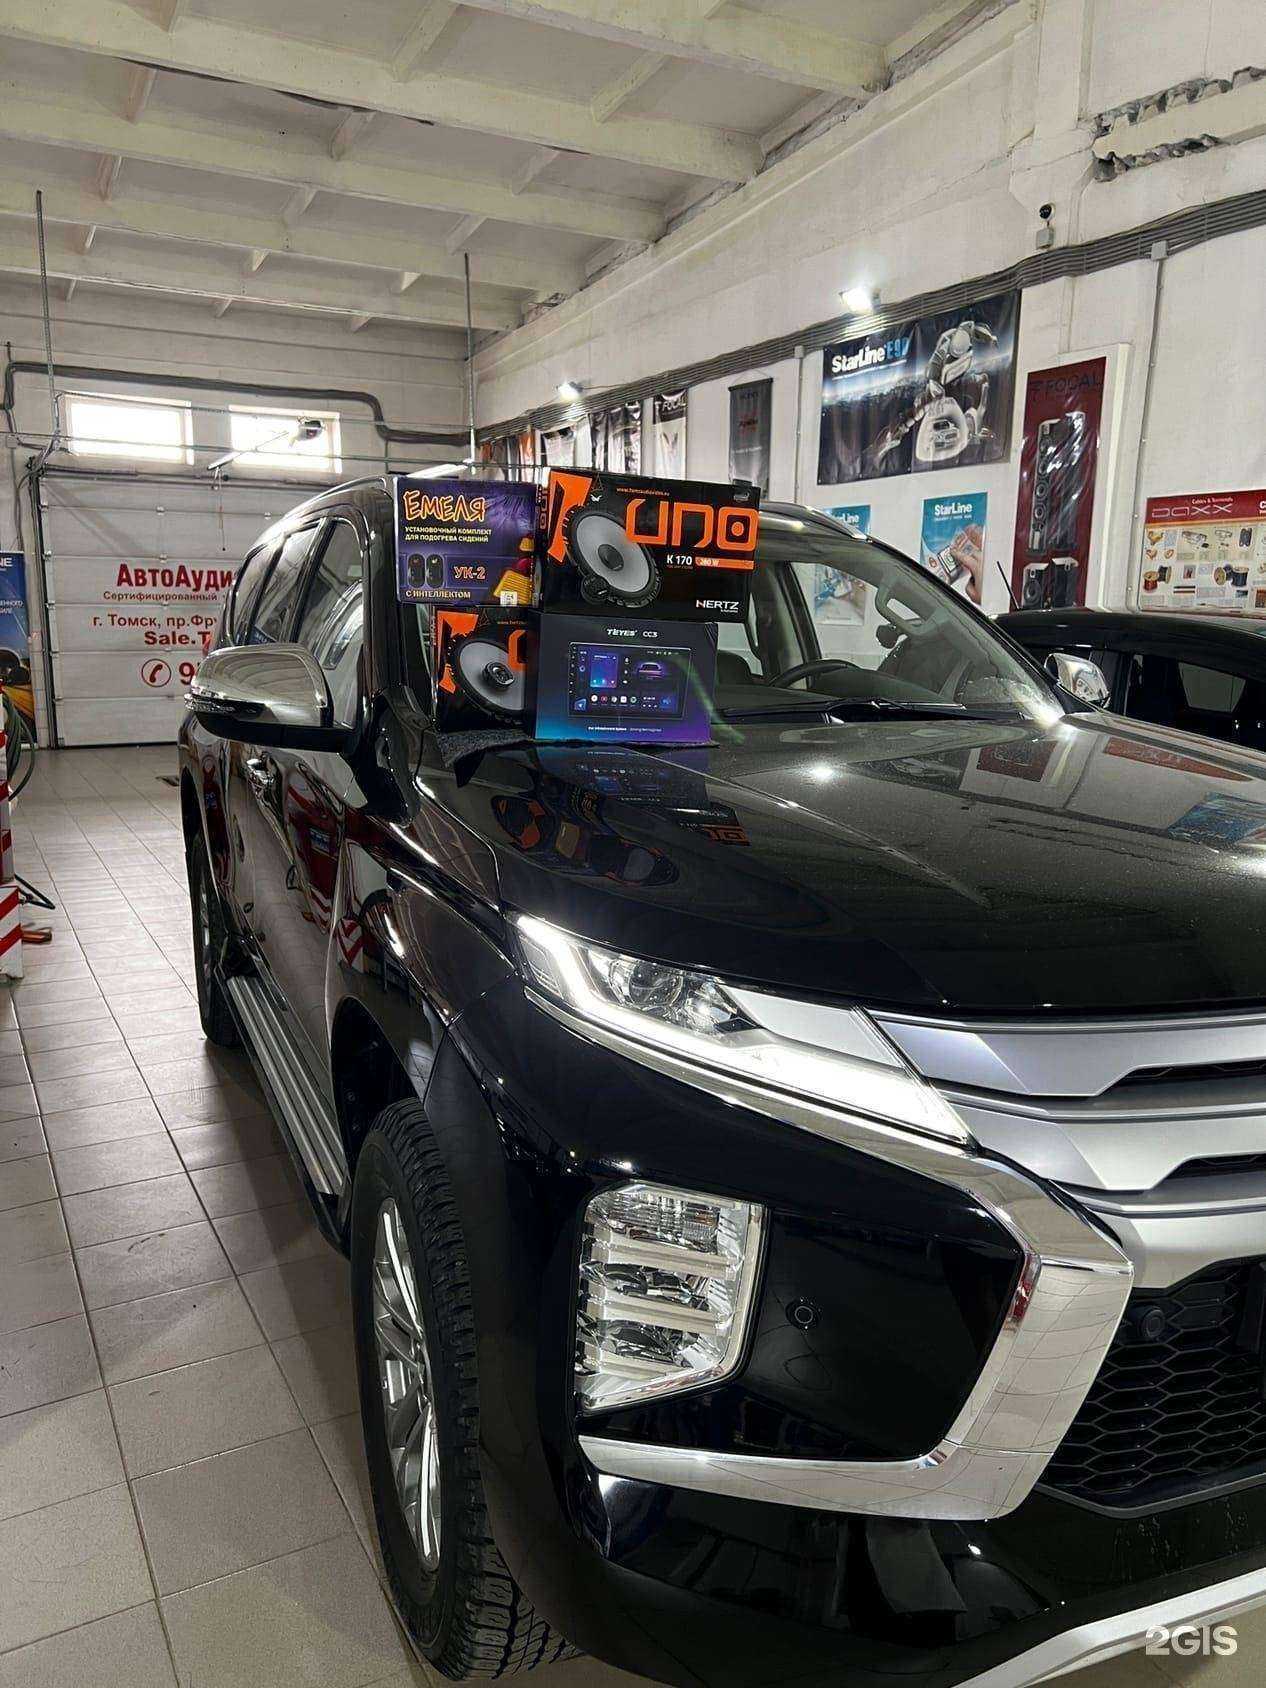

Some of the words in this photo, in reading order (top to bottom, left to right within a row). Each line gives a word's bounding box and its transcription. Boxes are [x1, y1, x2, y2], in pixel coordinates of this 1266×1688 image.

[832, 346, 886, 373] StarLine
[403, 490, 486, 522] ЕМЕЛЯ
[934, 502, 973, 516] StarLine
[404, 526, 457, 535] УСТАНОВОЧНЫЙ
[458, 527, 492, 536] КОМПЛЕКТ
[405, 534, 420, 542] ДЛЯ
[420, 534, 458, 542] ПОДОГРЕВА
[458, 535, 489, 543] СИДЕНИЙ
[666, 555, 674, 565] K
[675, 556, 693, 566] 170
[117, 563, 235, 592] АвтоАуди
[454, 565, 487, 580] УК-2
[103, 590, 218, 602] Сертифицированный
[412, 591, 471, 599] ИНТЕЛЛЕКТОМ
[695, 600, 740, 611] HERTZ
[93, 616, 103, 627] г.
[108, 613, 162, 629] Томск,
[606, 628, 637, 637] TEYES
[179, 662, 200, 686] 9
